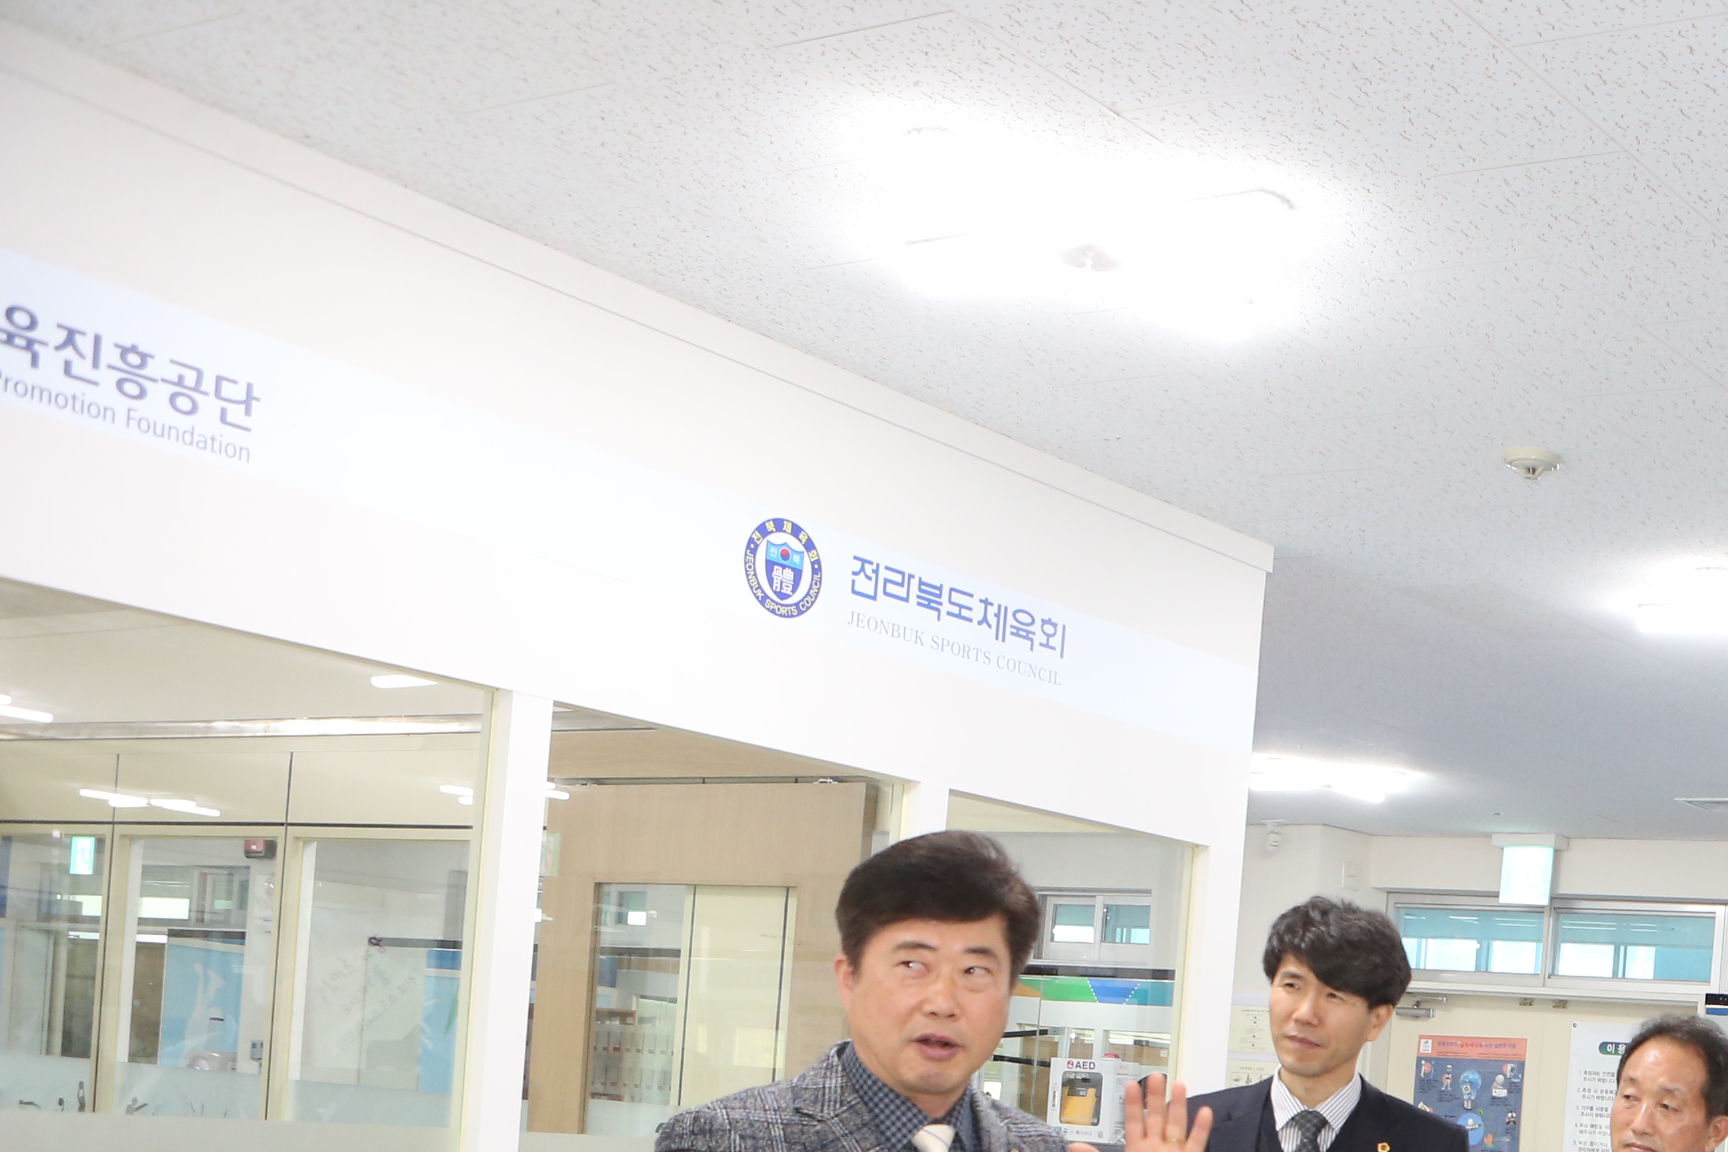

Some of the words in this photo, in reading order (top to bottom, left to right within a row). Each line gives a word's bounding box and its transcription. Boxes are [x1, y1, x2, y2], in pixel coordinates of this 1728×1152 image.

[0, 368, 116, 424] romotion
[126, 408, 250, 463] Foundation
[746, 549, 765, 601] JEONBUK
[764, 599, 798, 616] SPORTS
[799, 571, 821, 611] COUNCIL
[850, 555, 1067, 659] 전라북도체육회
[847, 610, 926, 648] JEONBUK
[931, 634, 993, 666] SPORTS
[996, 655, 1062, 686] COUNCIL
[1075, 1061, 1096, 1070] AED
